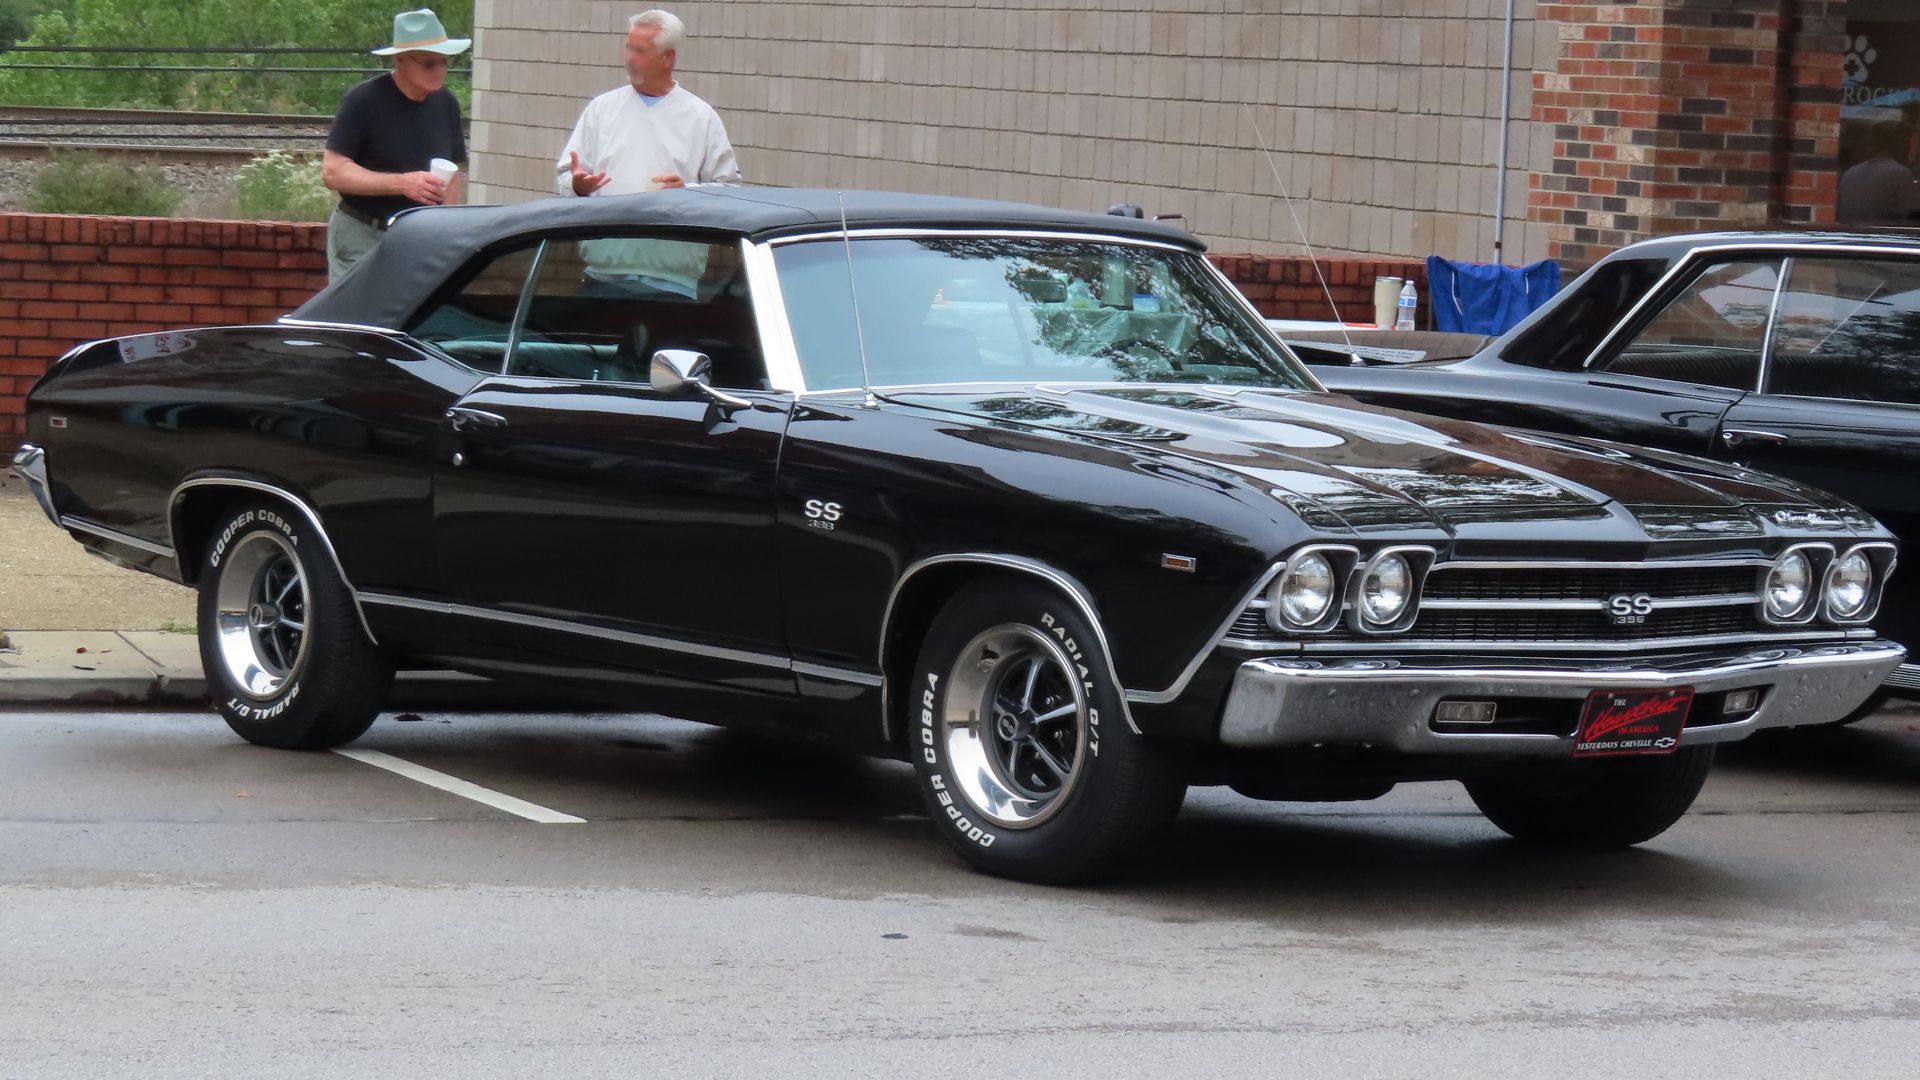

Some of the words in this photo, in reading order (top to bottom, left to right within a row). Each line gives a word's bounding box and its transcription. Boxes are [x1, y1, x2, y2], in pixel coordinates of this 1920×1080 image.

[804, 499, 842, 521] SS
[210, 511, 255, 568] COOPER
[258, 509, 299, 547] COBRA
[1611, 596, 1652, 615] SS
[253, 681, 300, 720] RADIAL
[1041, 612, 1093, 698] RADIAL
[1089, 707, 1099, 757] G/T
[921, 672, 939, 764] COBRA
[1577, 741, 1618, 750] YESTERDAYS
[1620, 739, 1652, 748] CHEVELLE
[931, 773, 996, 848] COOPER
